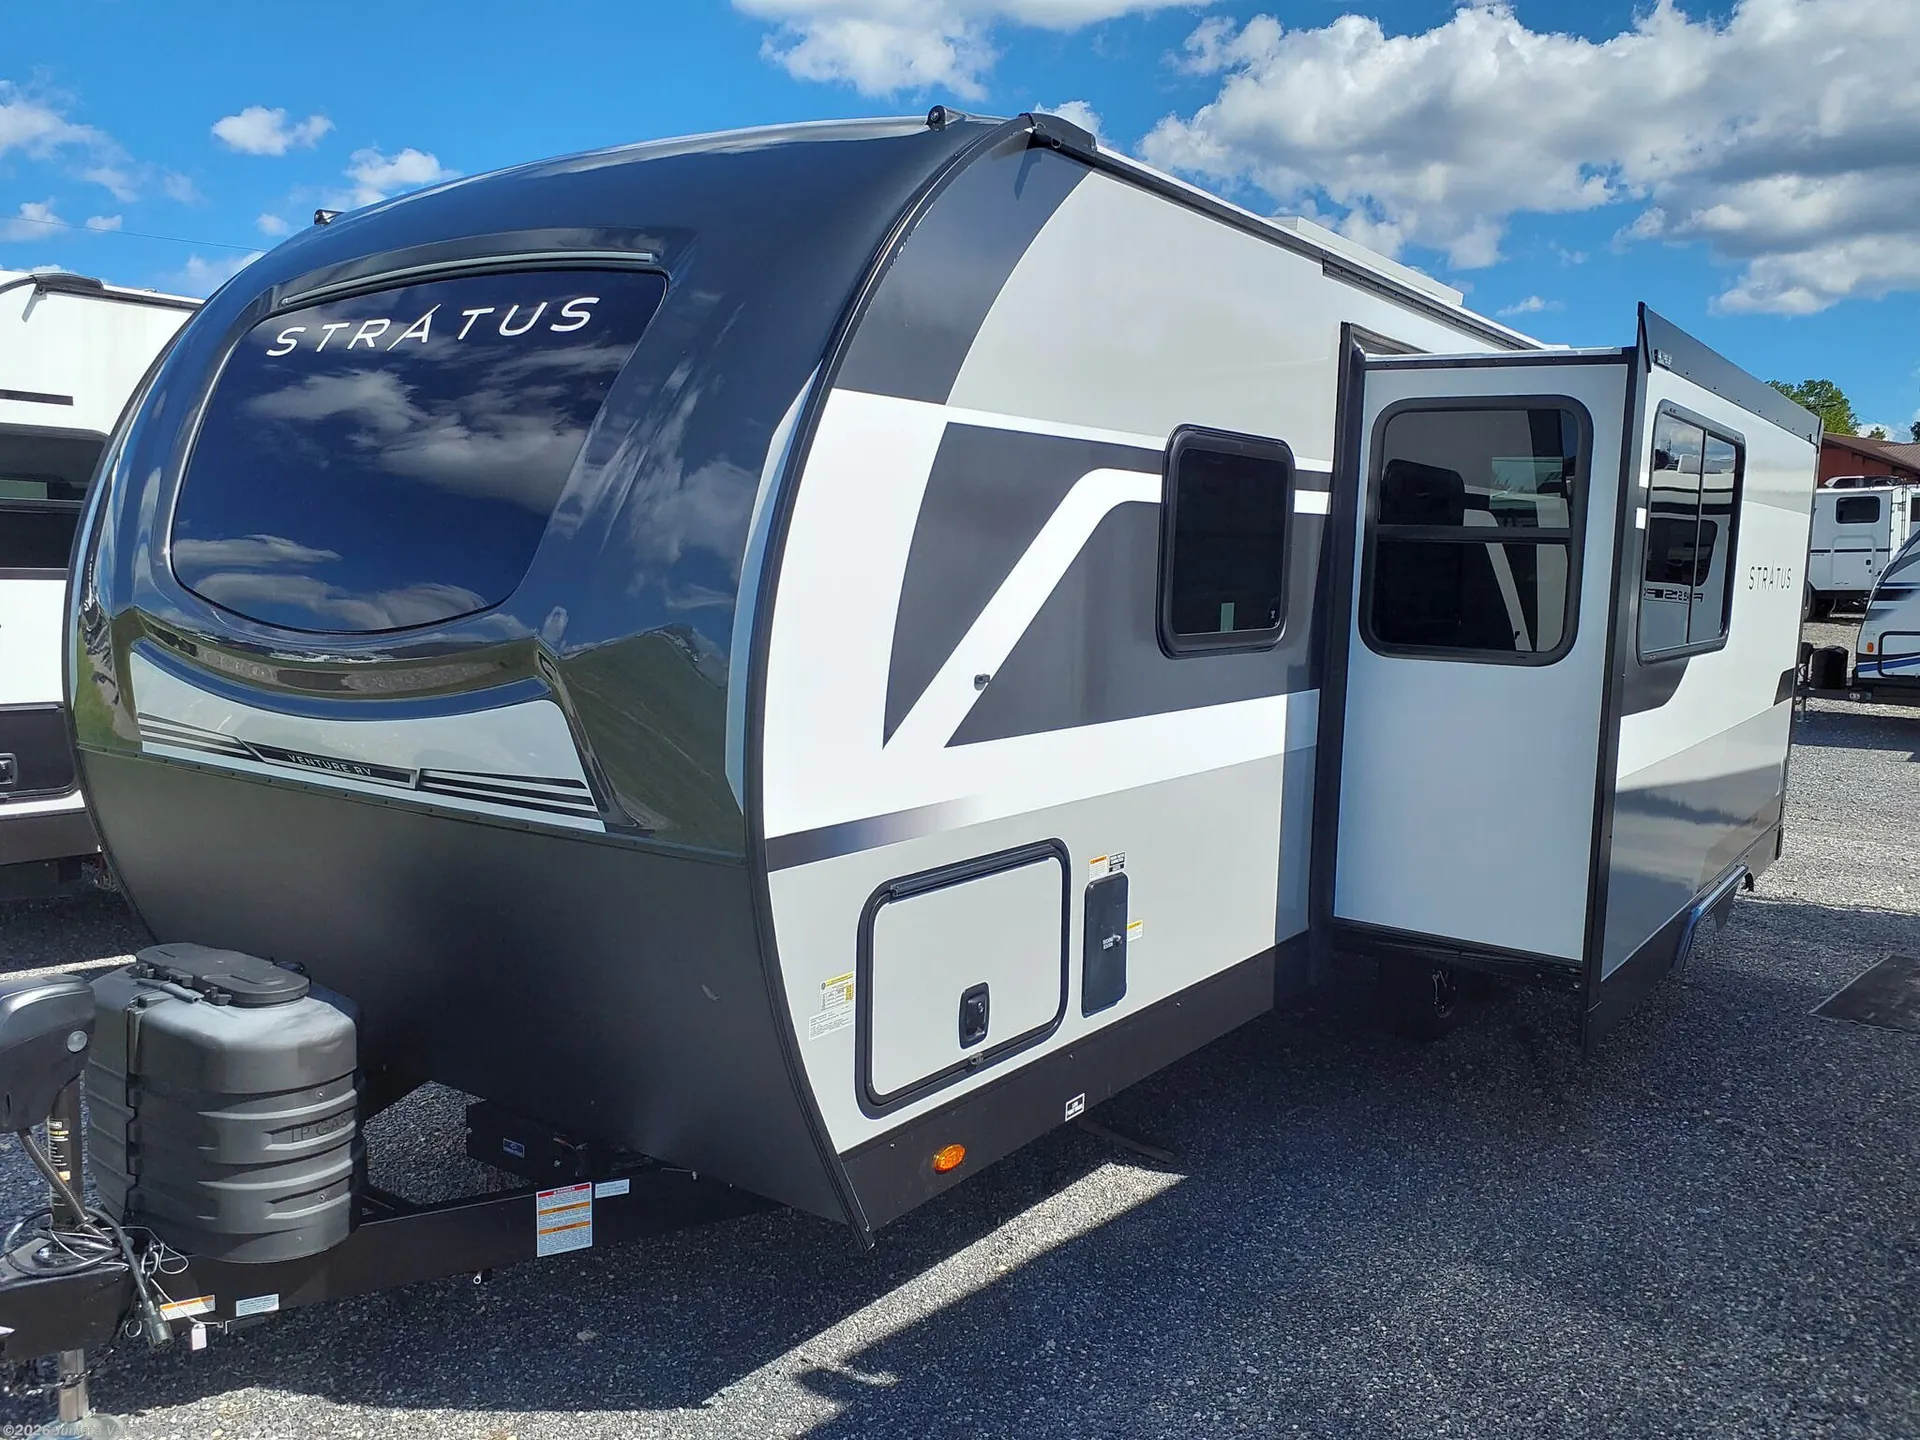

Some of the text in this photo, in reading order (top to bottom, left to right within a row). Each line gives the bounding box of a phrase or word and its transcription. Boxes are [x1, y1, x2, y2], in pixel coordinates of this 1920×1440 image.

[266, 297, 600, 357] STRATUS
[1748, 560, 1792, 591] STRATUS
[287, 753, 373, 776] VENTURE RV
[292, 1126, 311, 1143] LP
